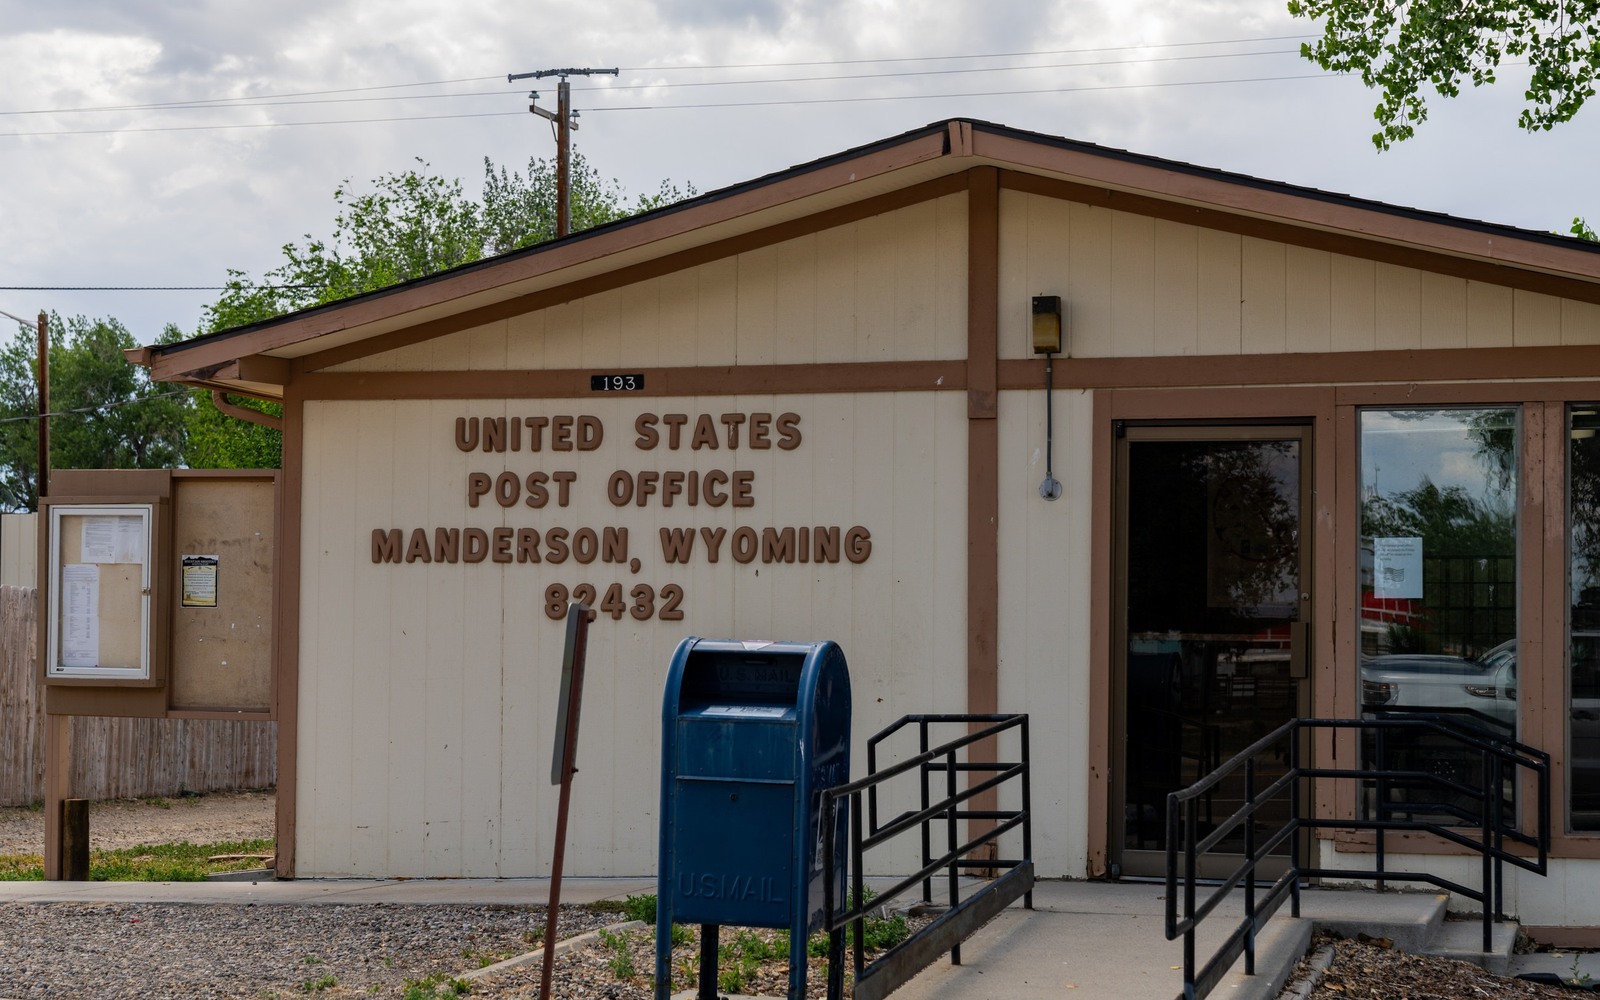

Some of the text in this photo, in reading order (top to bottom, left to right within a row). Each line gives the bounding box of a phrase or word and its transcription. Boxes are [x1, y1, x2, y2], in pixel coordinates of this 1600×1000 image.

[603, 376, 635, 390] 193
[454, 412, 802, 453] UNITED STATES
[467, 469, 755, 509] POST OFFICE
[371, 525, 872, 574] MANDERSON, WYOMING
[544, 582, 684, 621] 82432
